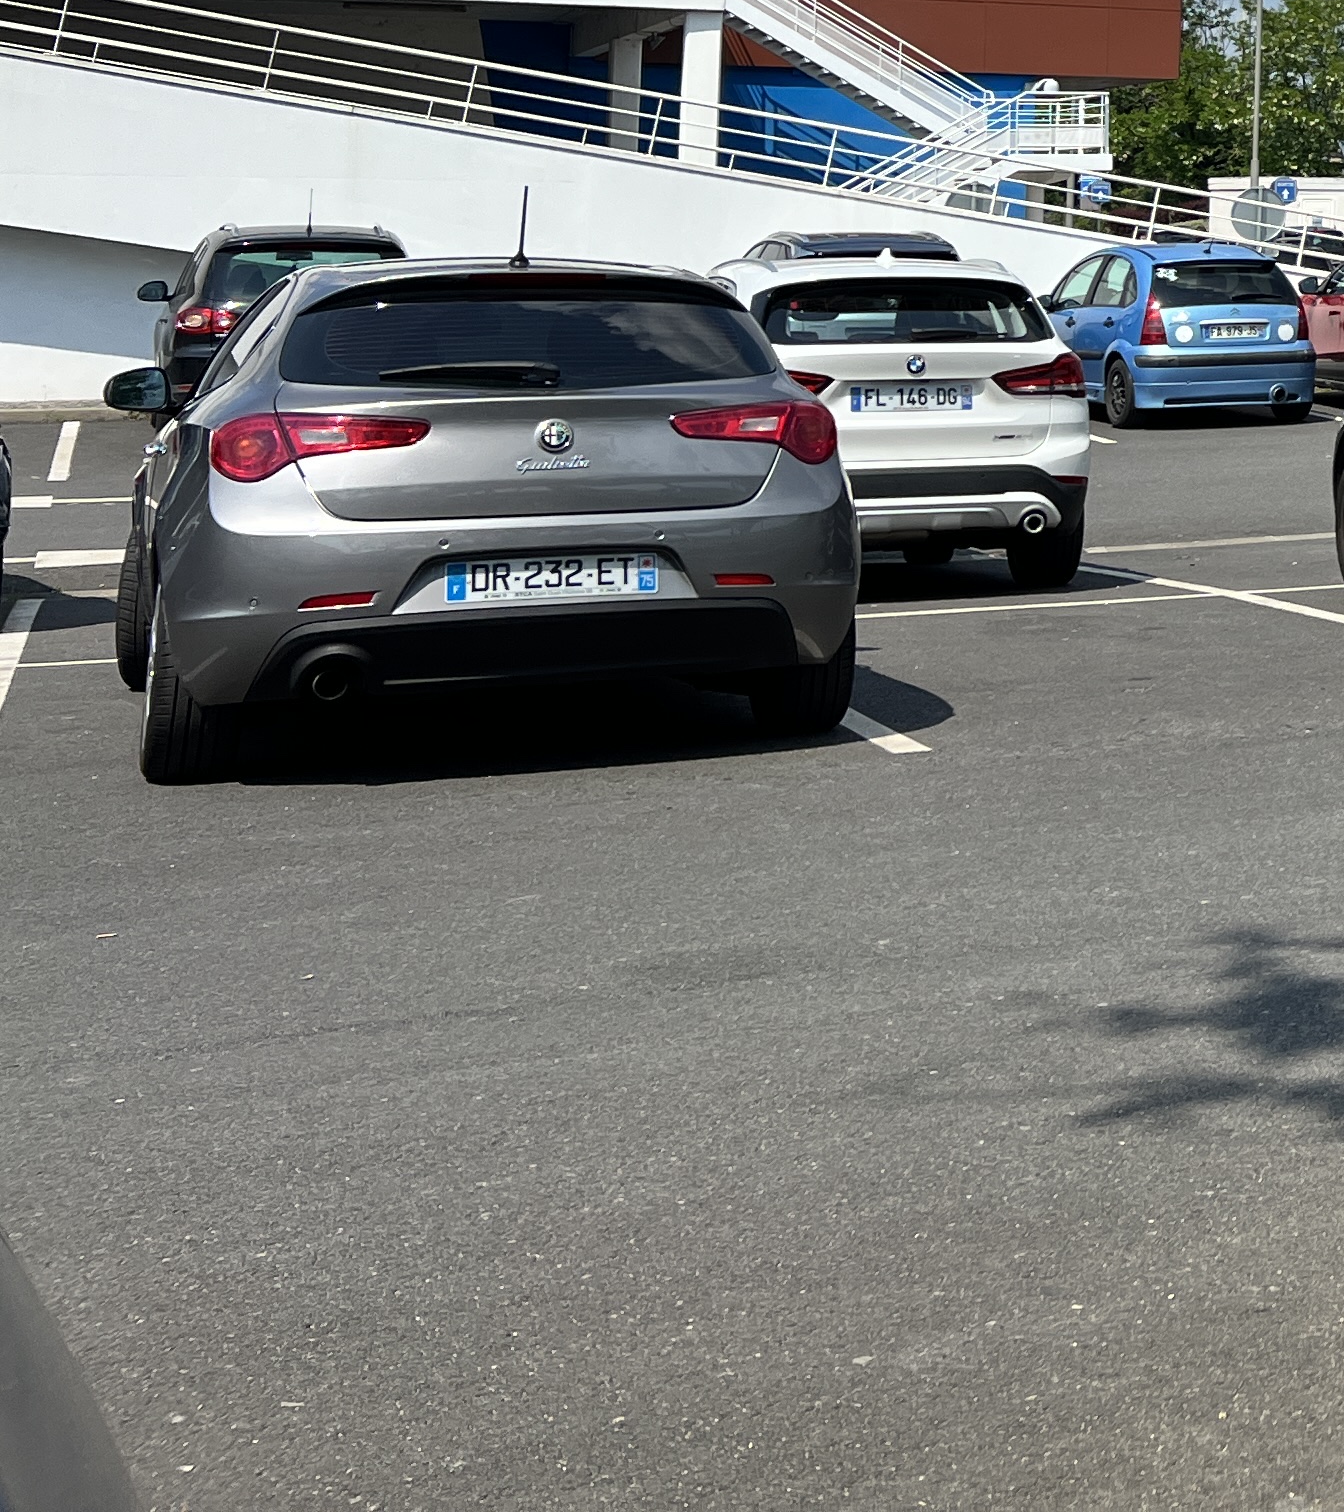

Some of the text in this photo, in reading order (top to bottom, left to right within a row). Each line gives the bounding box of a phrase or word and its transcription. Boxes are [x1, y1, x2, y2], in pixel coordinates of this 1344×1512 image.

[864, 388, 958, 407] FL-146-DG
[471, 557, 635, 593] DR-232-ET
[640, 574, 654, 587] 75
[453, 585, 460, 595] F
